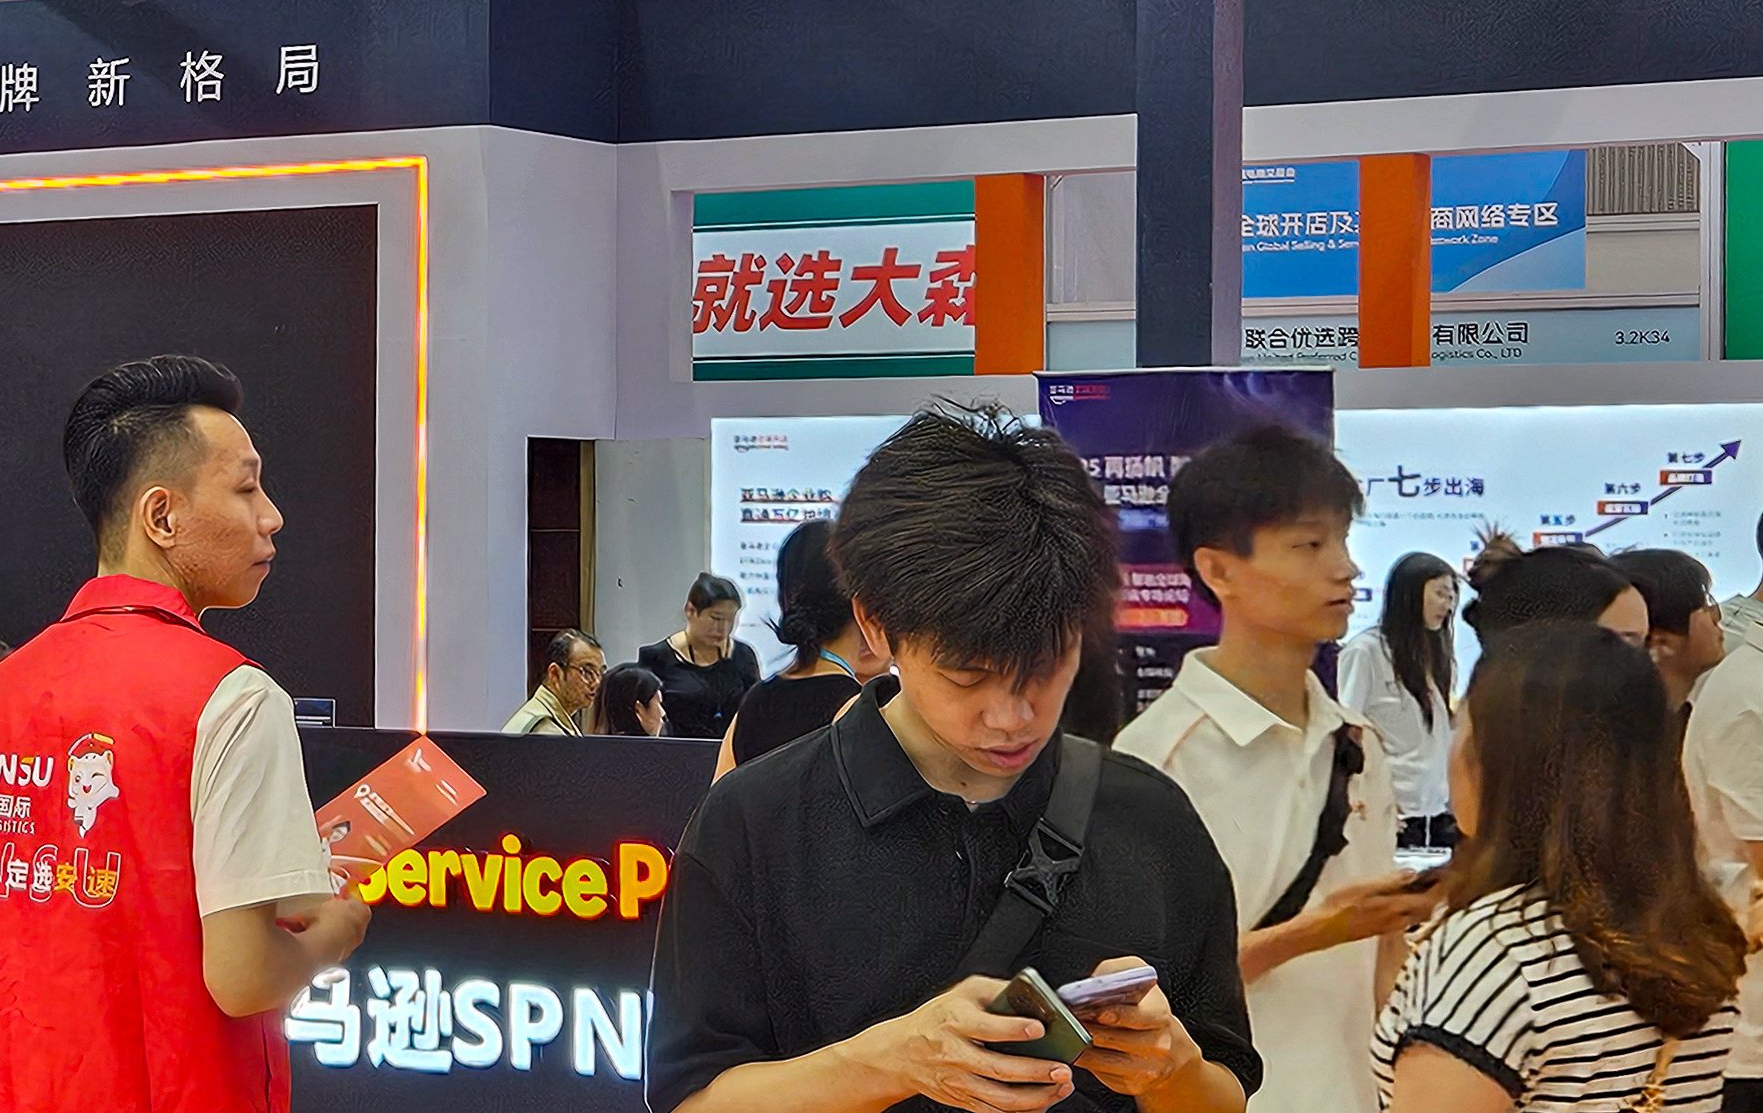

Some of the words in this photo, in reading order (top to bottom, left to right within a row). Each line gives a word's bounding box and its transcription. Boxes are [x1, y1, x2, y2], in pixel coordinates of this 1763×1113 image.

[1242, 210, 1359, 238] 全球开店及
[1433, 322, 1529, 345] 有限公司
[1614, 330, 1670, 345] 3.2K34
[1358, 464, 1485, 498] 厂七步出海
